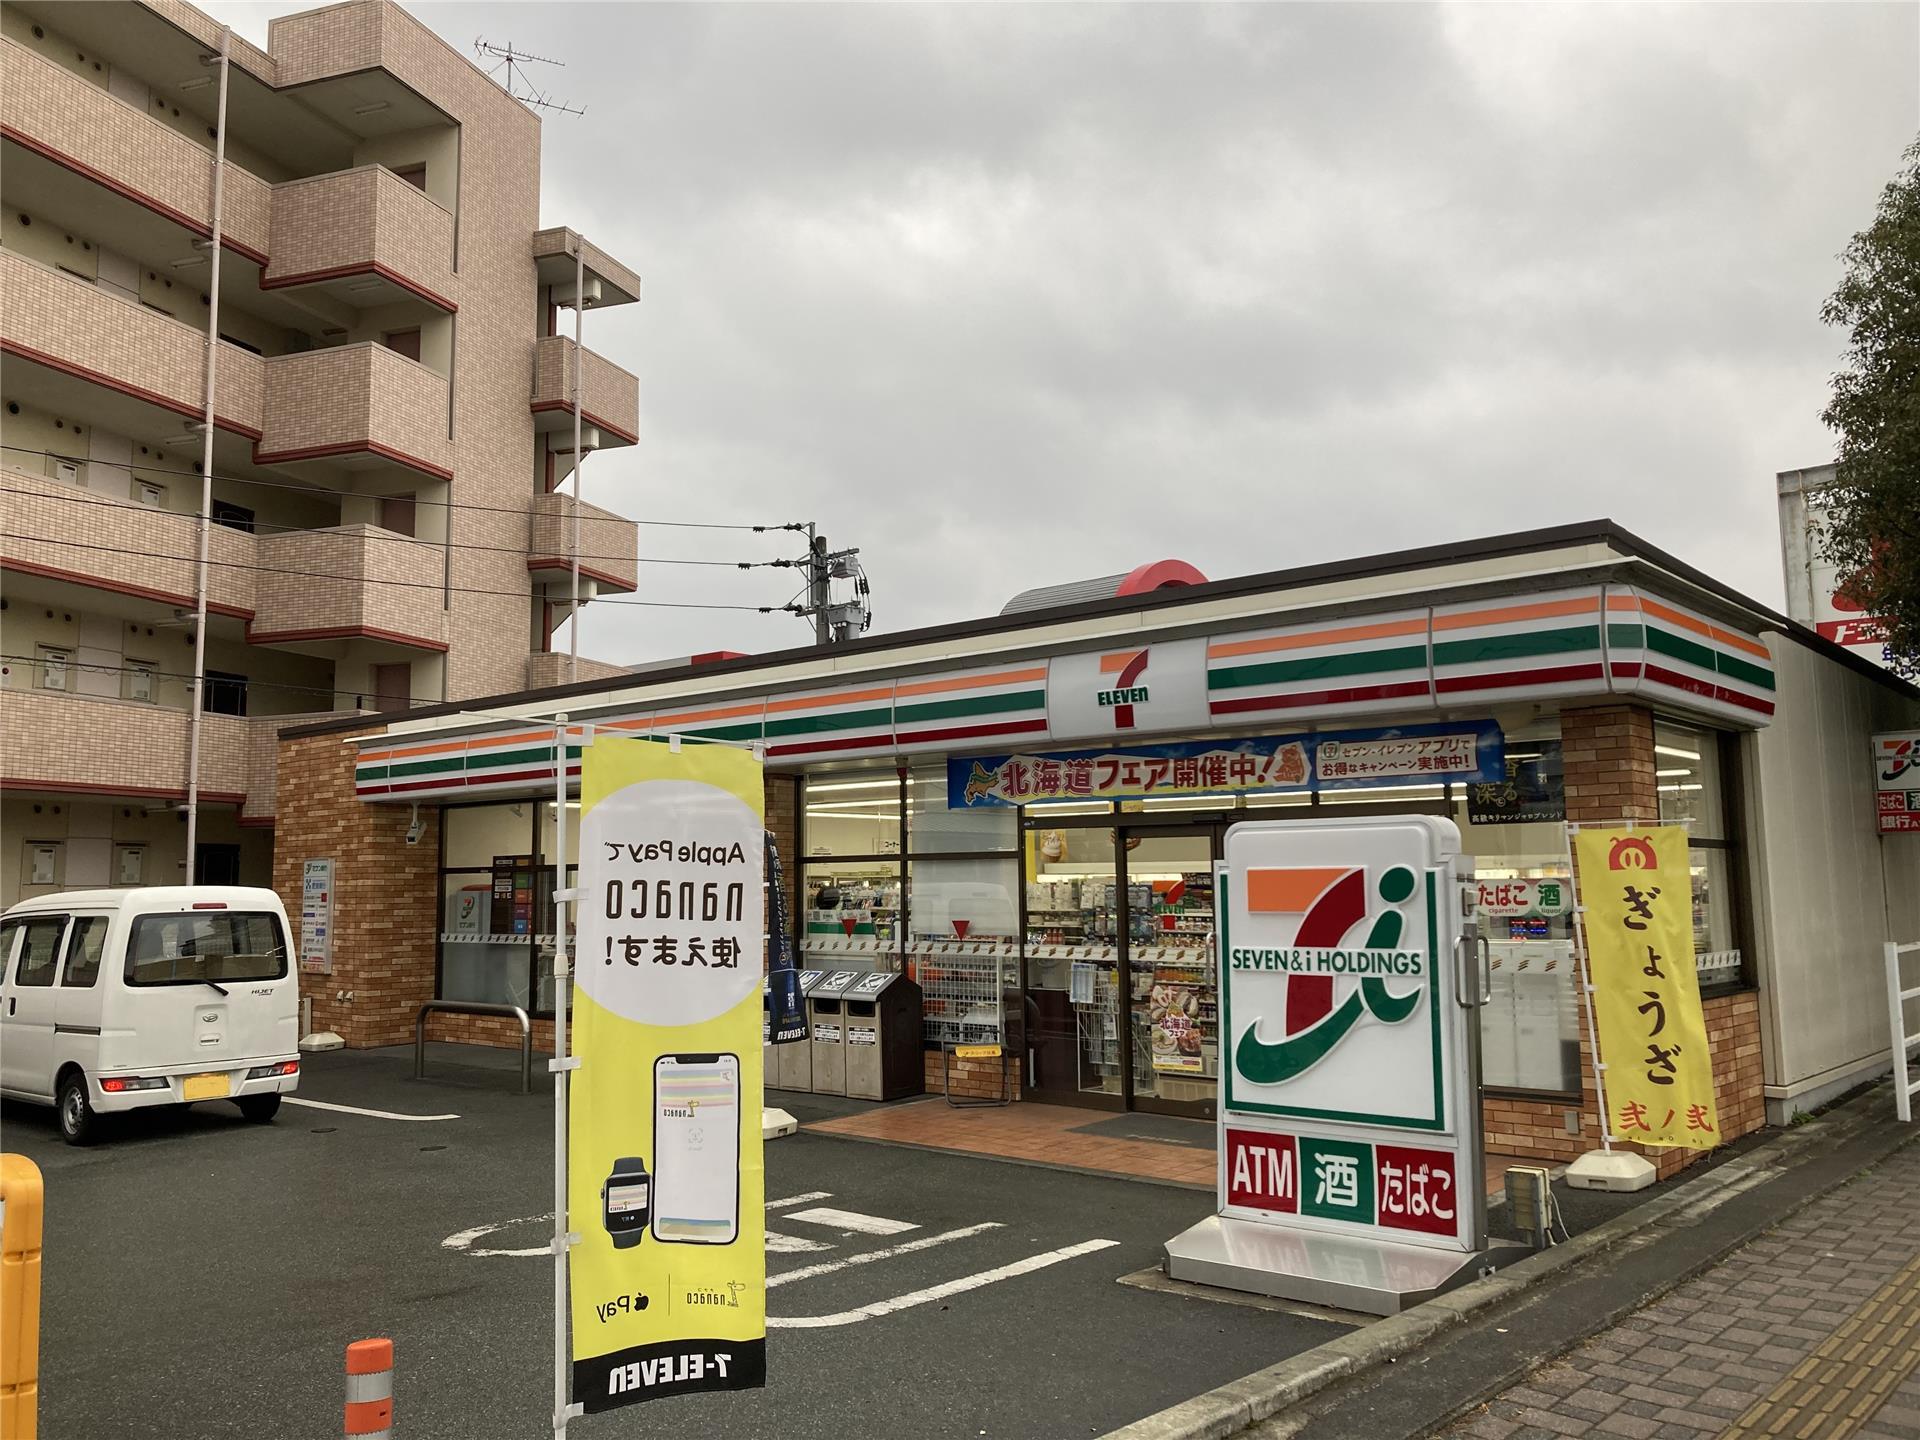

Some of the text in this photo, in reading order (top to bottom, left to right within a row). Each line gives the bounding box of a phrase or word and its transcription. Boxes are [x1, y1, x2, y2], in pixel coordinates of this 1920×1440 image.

[1001, 754, 1276, 797] 北海道フェア開催中!
[1478, 884, 1529, 907] たばこ
[1537, 884, 1561, 907] 酒
[1317, 951, 1422, 975] HOLDINGS
[251, 988, 274, 996] HIJET
[1622, 885, 1682, 1086] ぎょうざ
[1160, 1017, 1192, 1031] 北海道
[1232, 1144, 1455, 1220] ATM 酒 たばこ
